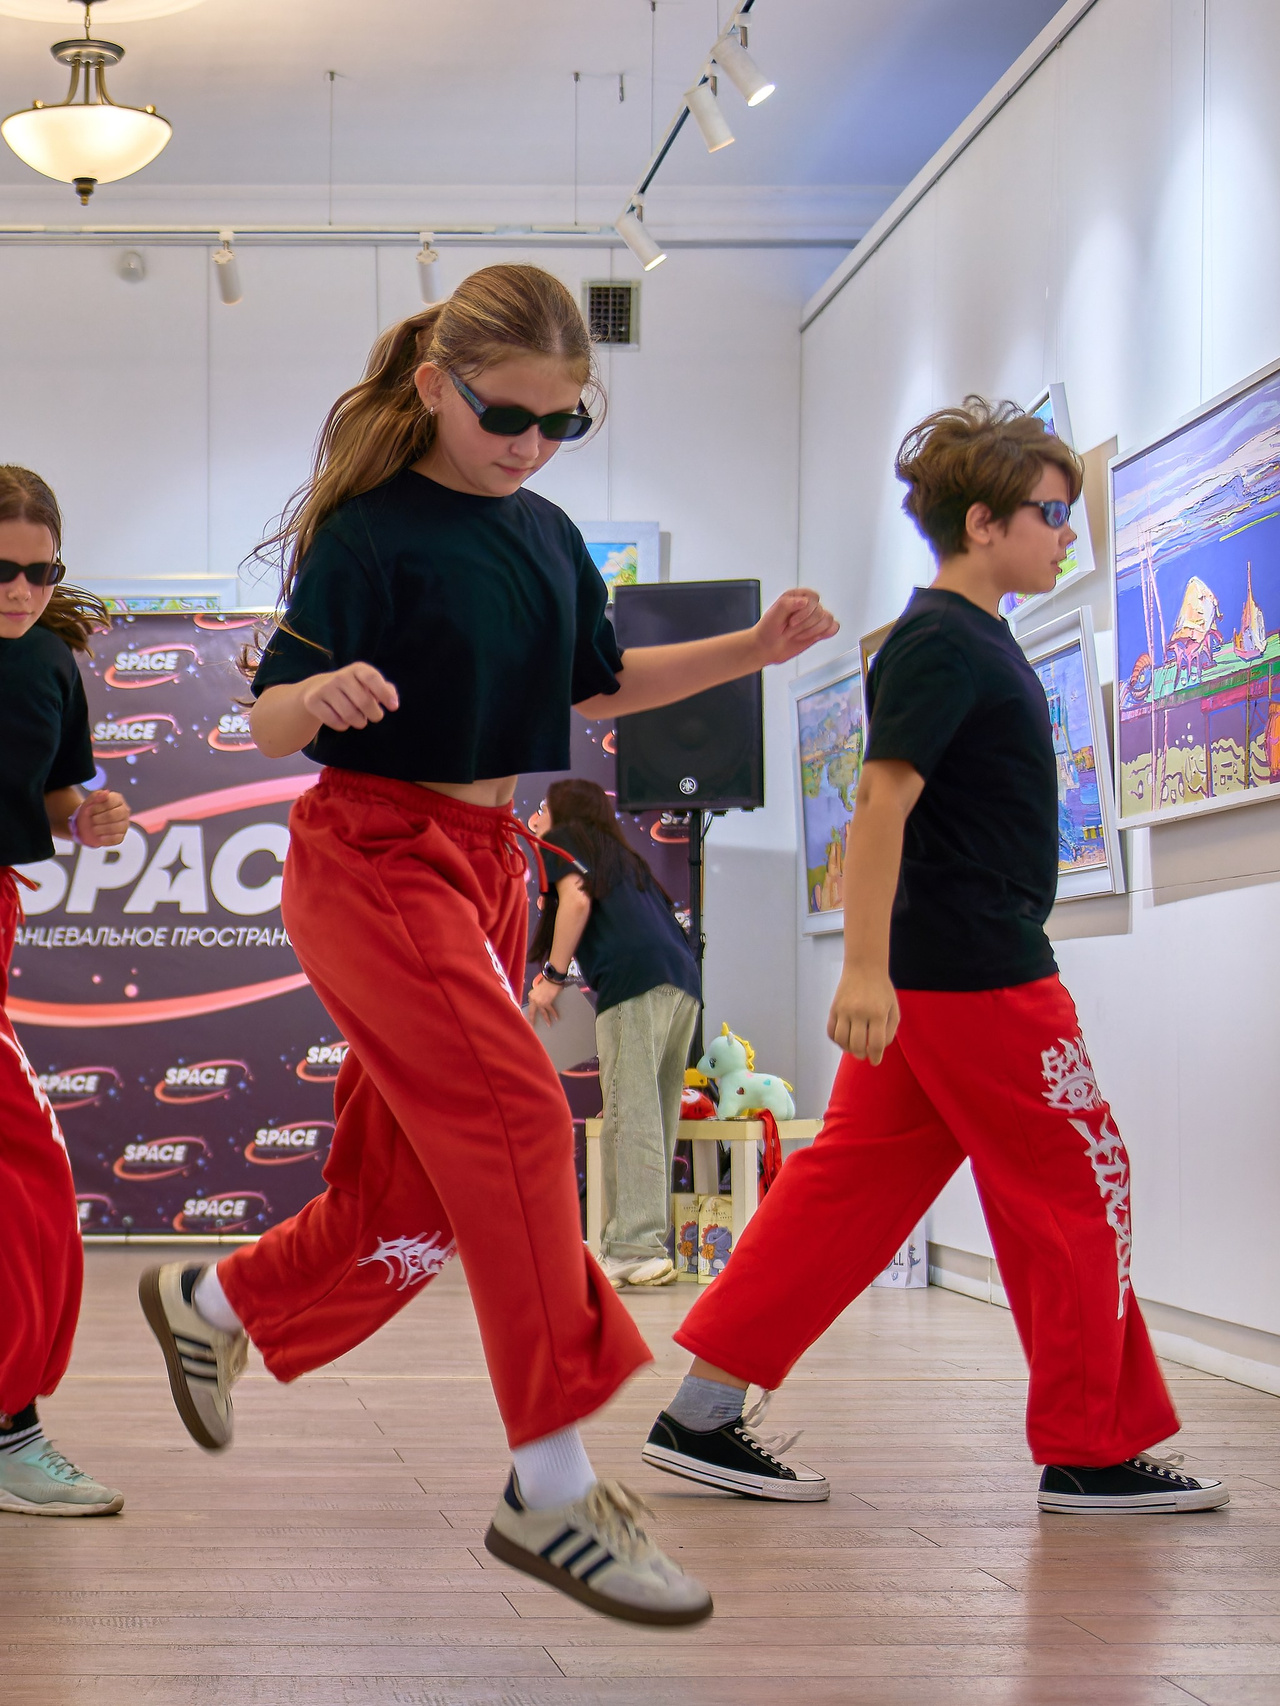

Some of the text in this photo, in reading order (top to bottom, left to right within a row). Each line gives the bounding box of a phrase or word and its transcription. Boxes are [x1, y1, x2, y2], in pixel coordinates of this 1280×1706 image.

[114, 651, 179, 671] SPACE
[93, 721, 158, 741] SPACE
[218, 714, 250, 733] SPA
[12, 822, 291, 915] SPAC
[14, 926, 293, 949] АНЦЕВАЛЬНОЕ ПРОСТРАН
[306, 1046, 349, 1064] SPA
[165, 1068, 228, 1086] SPACE
[255, 1129, 318, 1146] SPACE
[124, 1144, 187, 1162] SPACE
[183, 1200, 247, 1217] SPACE
